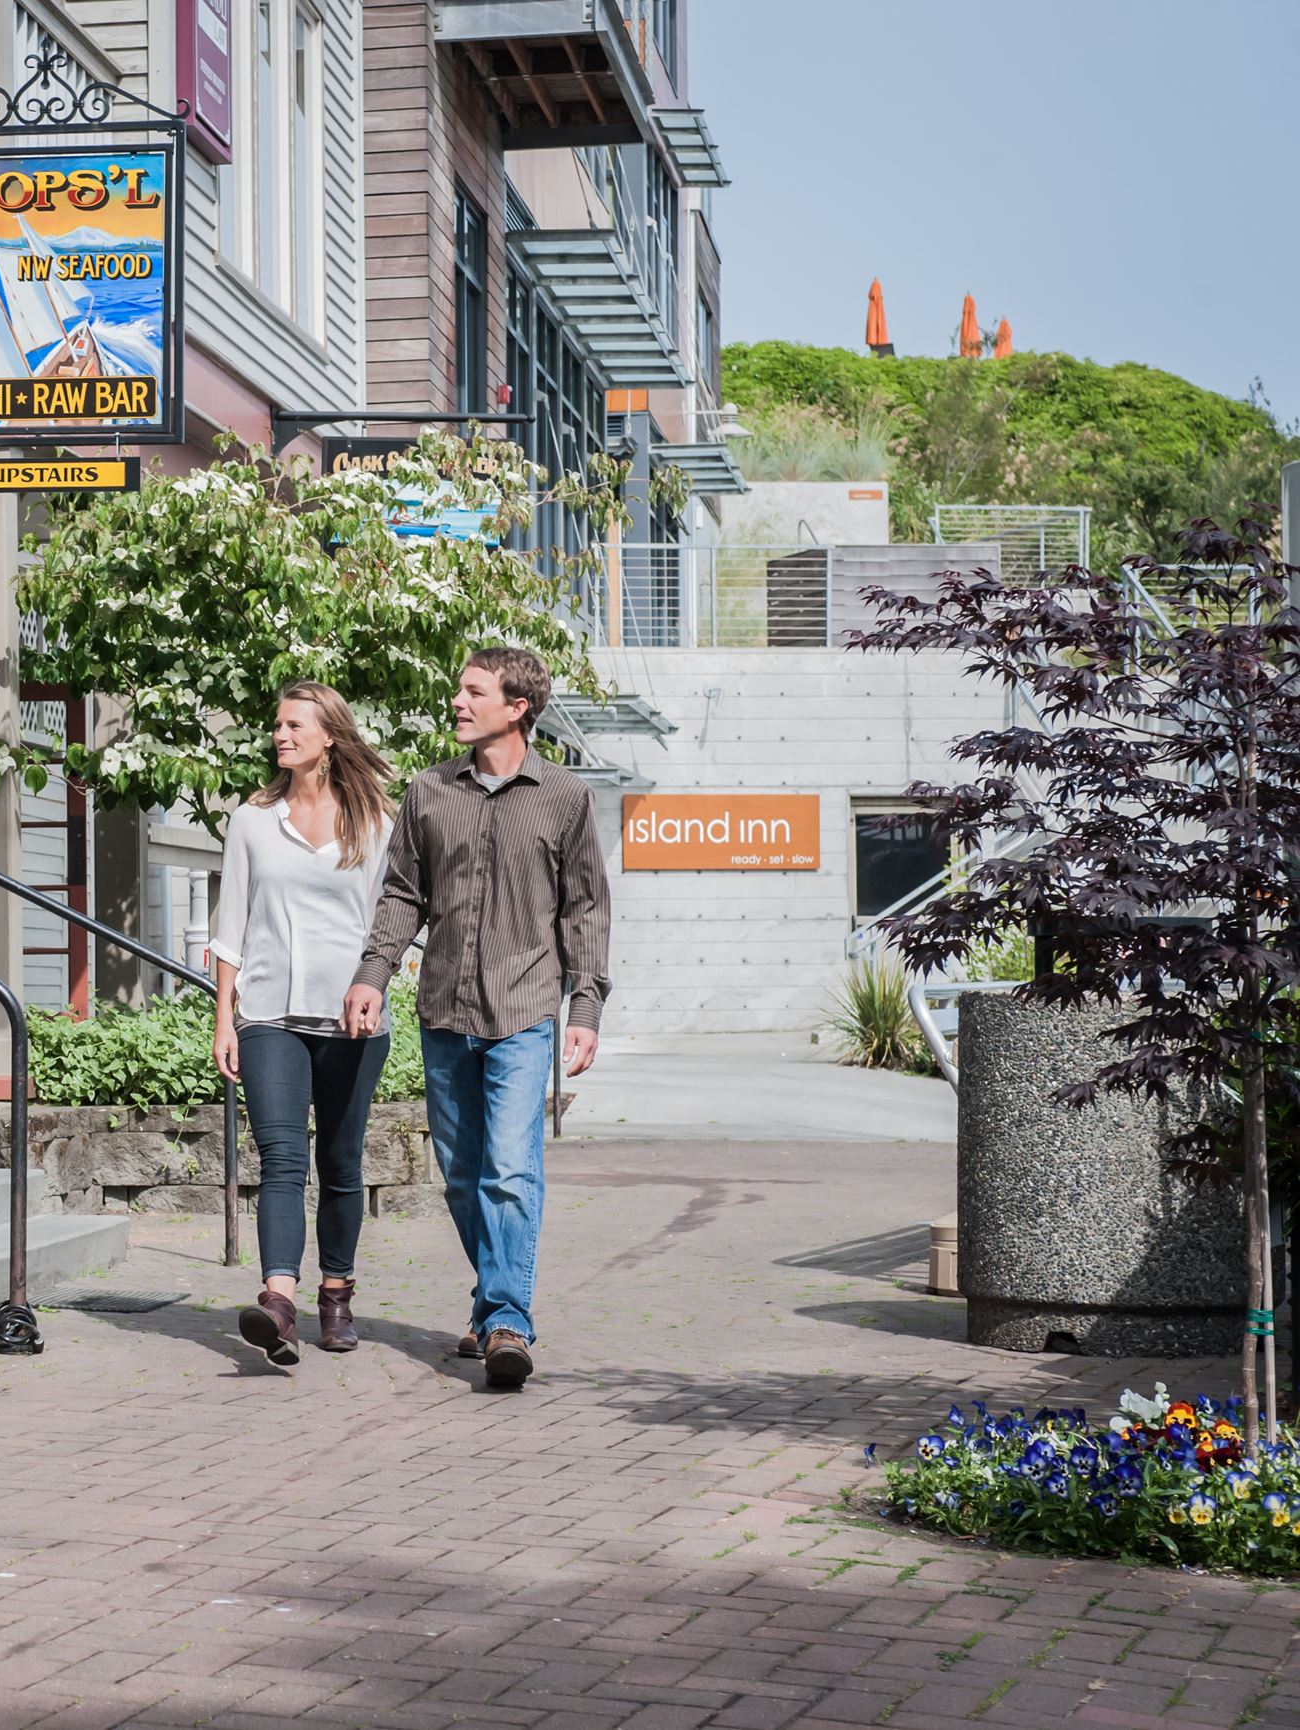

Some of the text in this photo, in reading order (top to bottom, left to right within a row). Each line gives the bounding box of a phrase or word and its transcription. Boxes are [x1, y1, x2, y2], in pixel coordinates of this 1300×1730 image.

[17, 253, 152, 282] NW SEAFOOD
[33, 383, 88, 415] RAW
[95, 381, 148, 414] BAR
[628, 811, 791, 844] island inn
[731, 854, 814, 866] ready set slow
